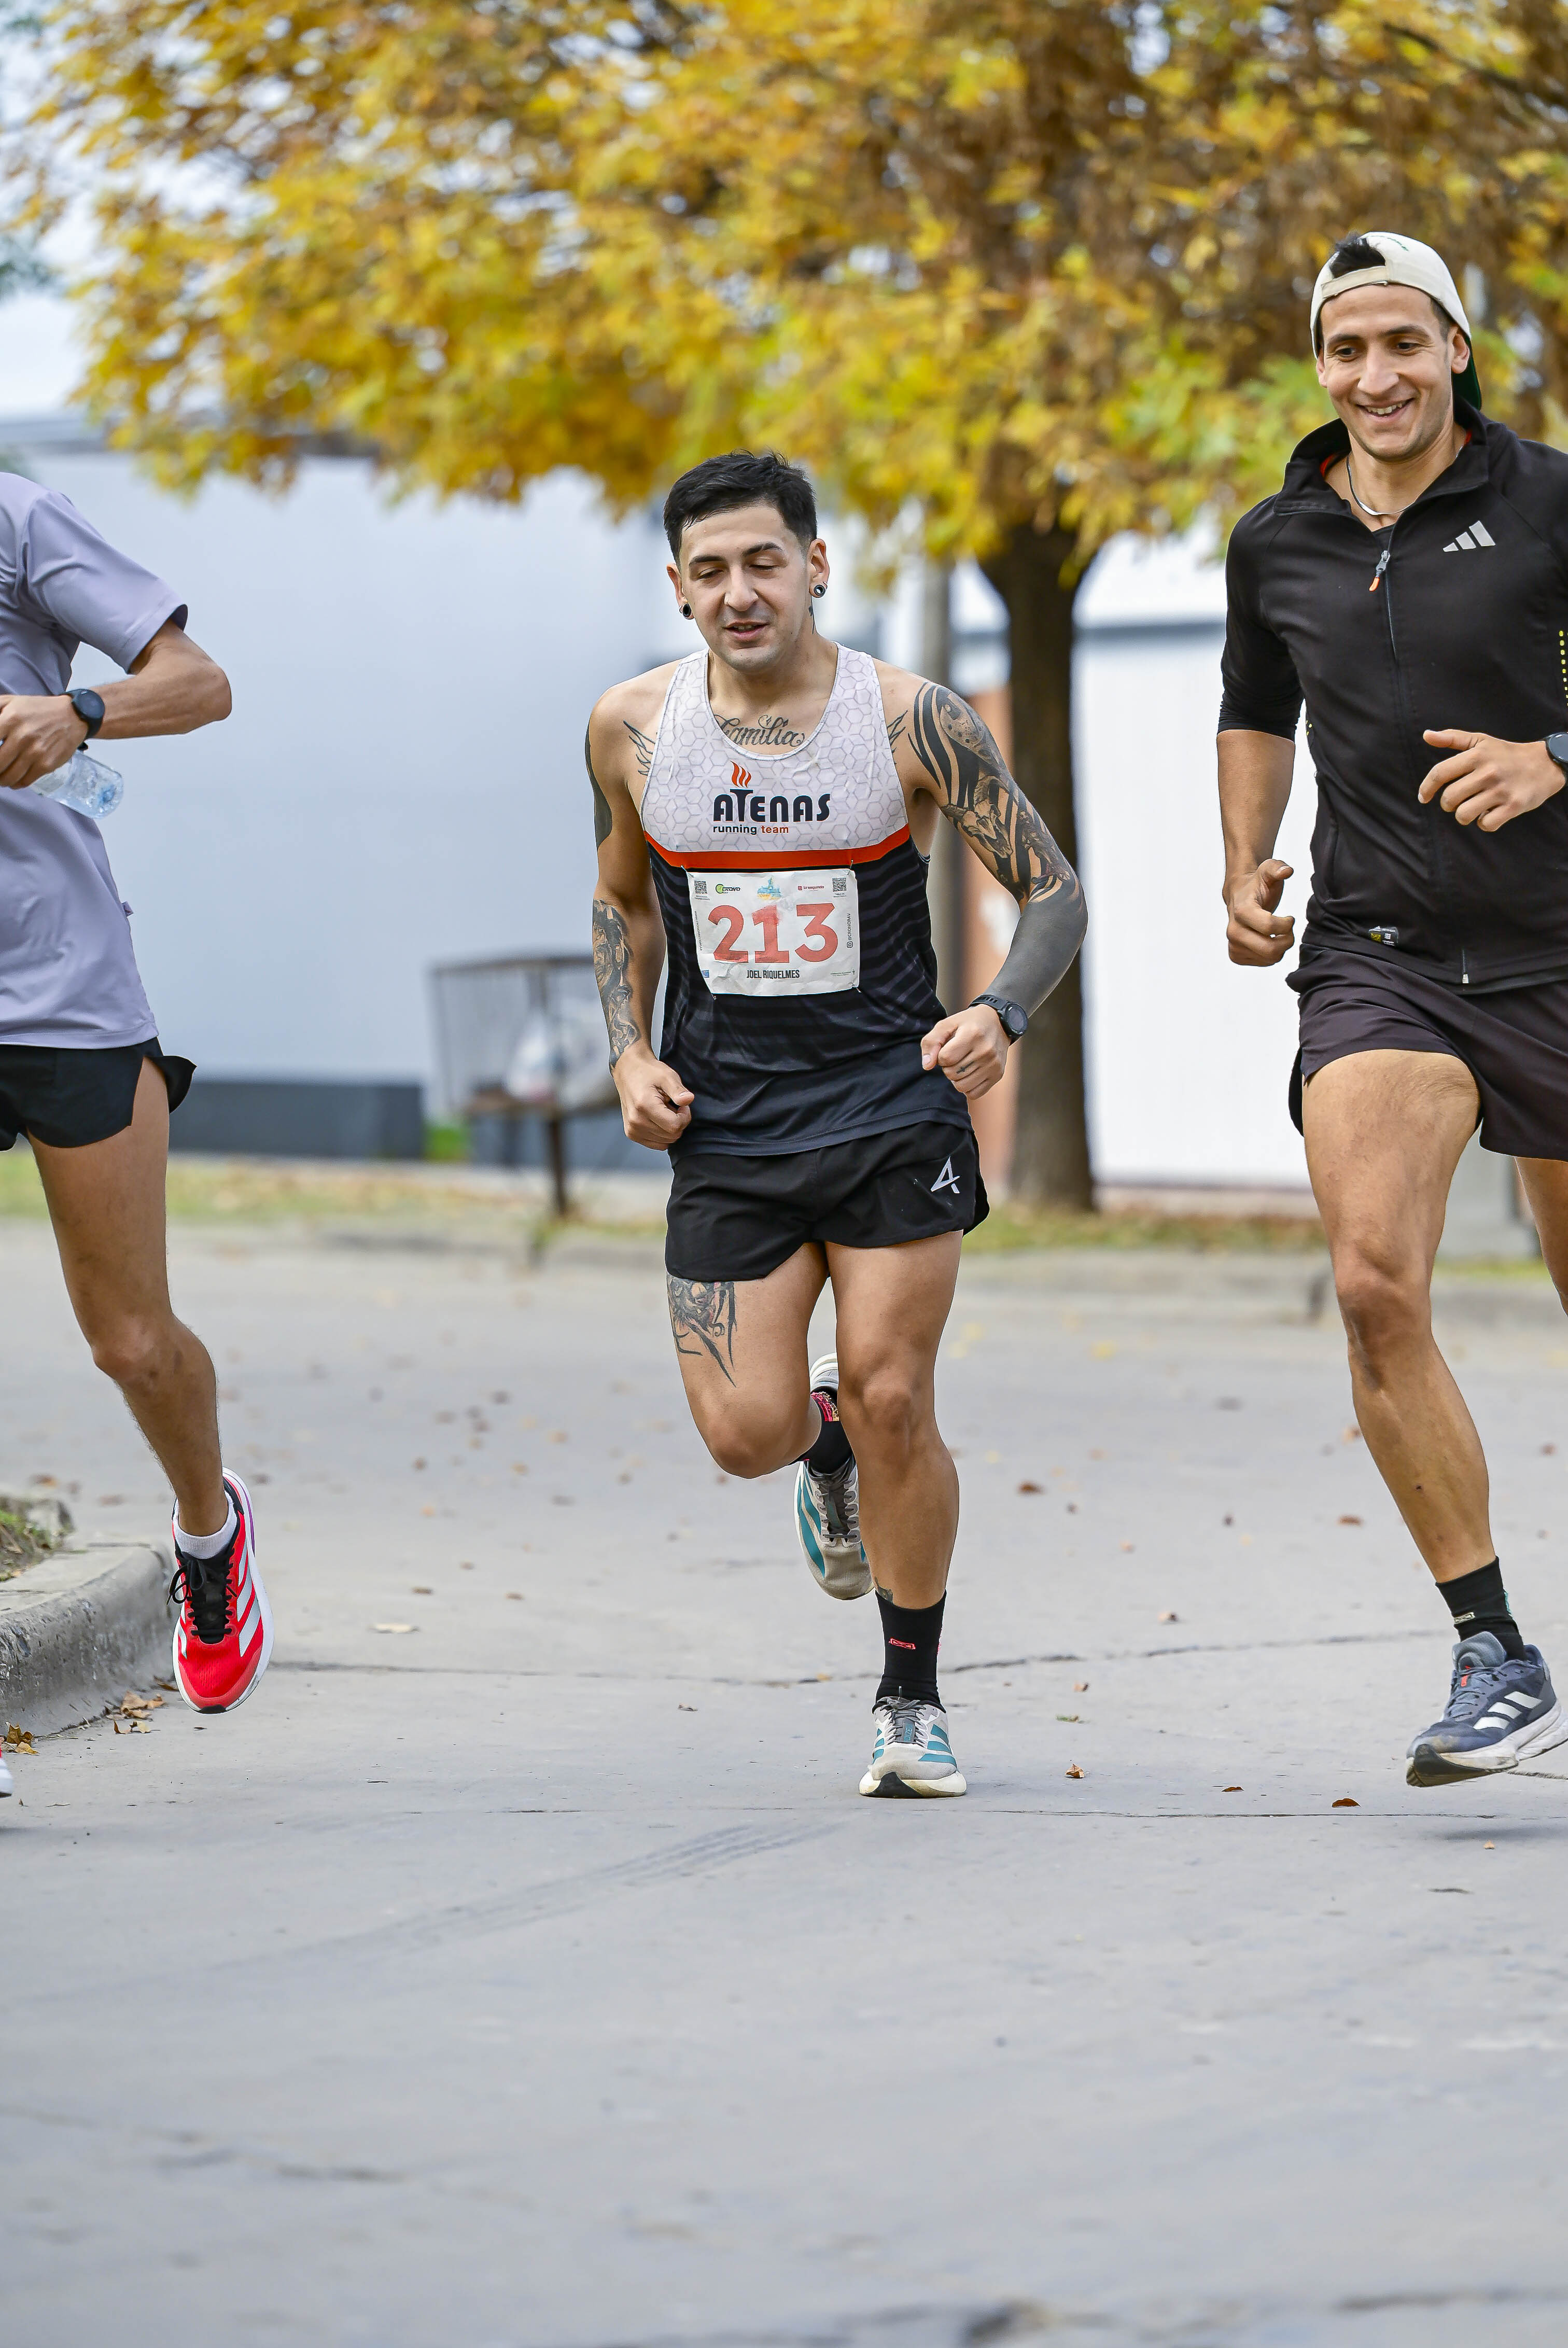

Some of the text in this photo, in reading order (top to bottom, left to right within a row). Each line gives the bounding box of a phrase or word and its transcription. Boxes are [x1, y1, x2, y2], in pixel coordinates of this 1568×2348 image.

[713, 789, 831, 822] ATENAS
[713, 824, 757, 835] running
[708, 903, 838, 963] 213
[746, 969, 800, 980] JOEL RIQUELMES
